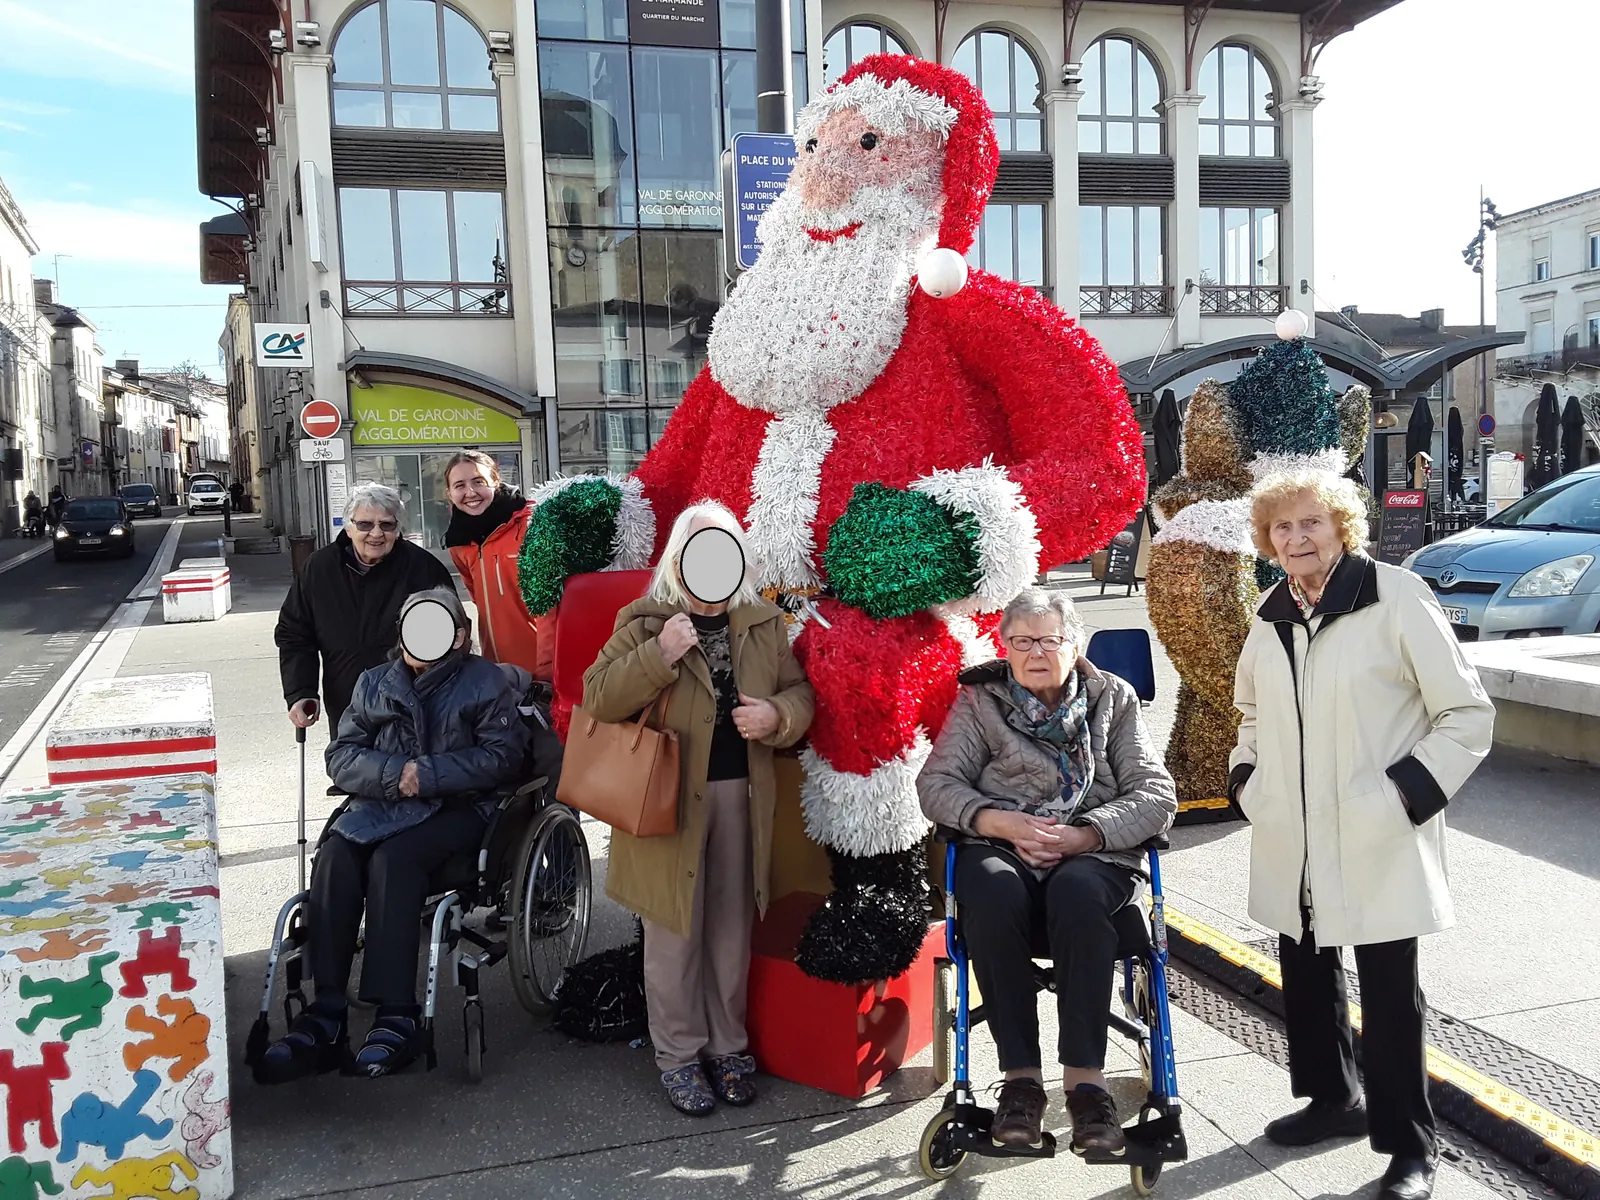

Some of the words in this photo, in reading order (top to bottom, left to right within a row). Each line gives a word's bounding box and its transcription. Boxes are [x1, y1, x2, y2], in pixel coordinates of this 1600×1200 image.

[741, 155, 769, 166] PLACE
[772, 156, 784, 166] DU
[755, 180, 789, 189] STATIONN
[638, 189, 657, 200] VAL
[659, 189, 673, 200] DE
[675, 190, 723, 202] GARONNE
[638, 203, 723, 216] AGGLOMÉRATION
[741, 203, 755, 211] SUR
[357, 409, 386, 422] VAL
[389, 408, 409, 422] DE
[413, 407, 486, 421] GARONNE
[358, 424, 488, 441] AGGLOMÉRATION
[1442, 608, 1461, 621] -YS
